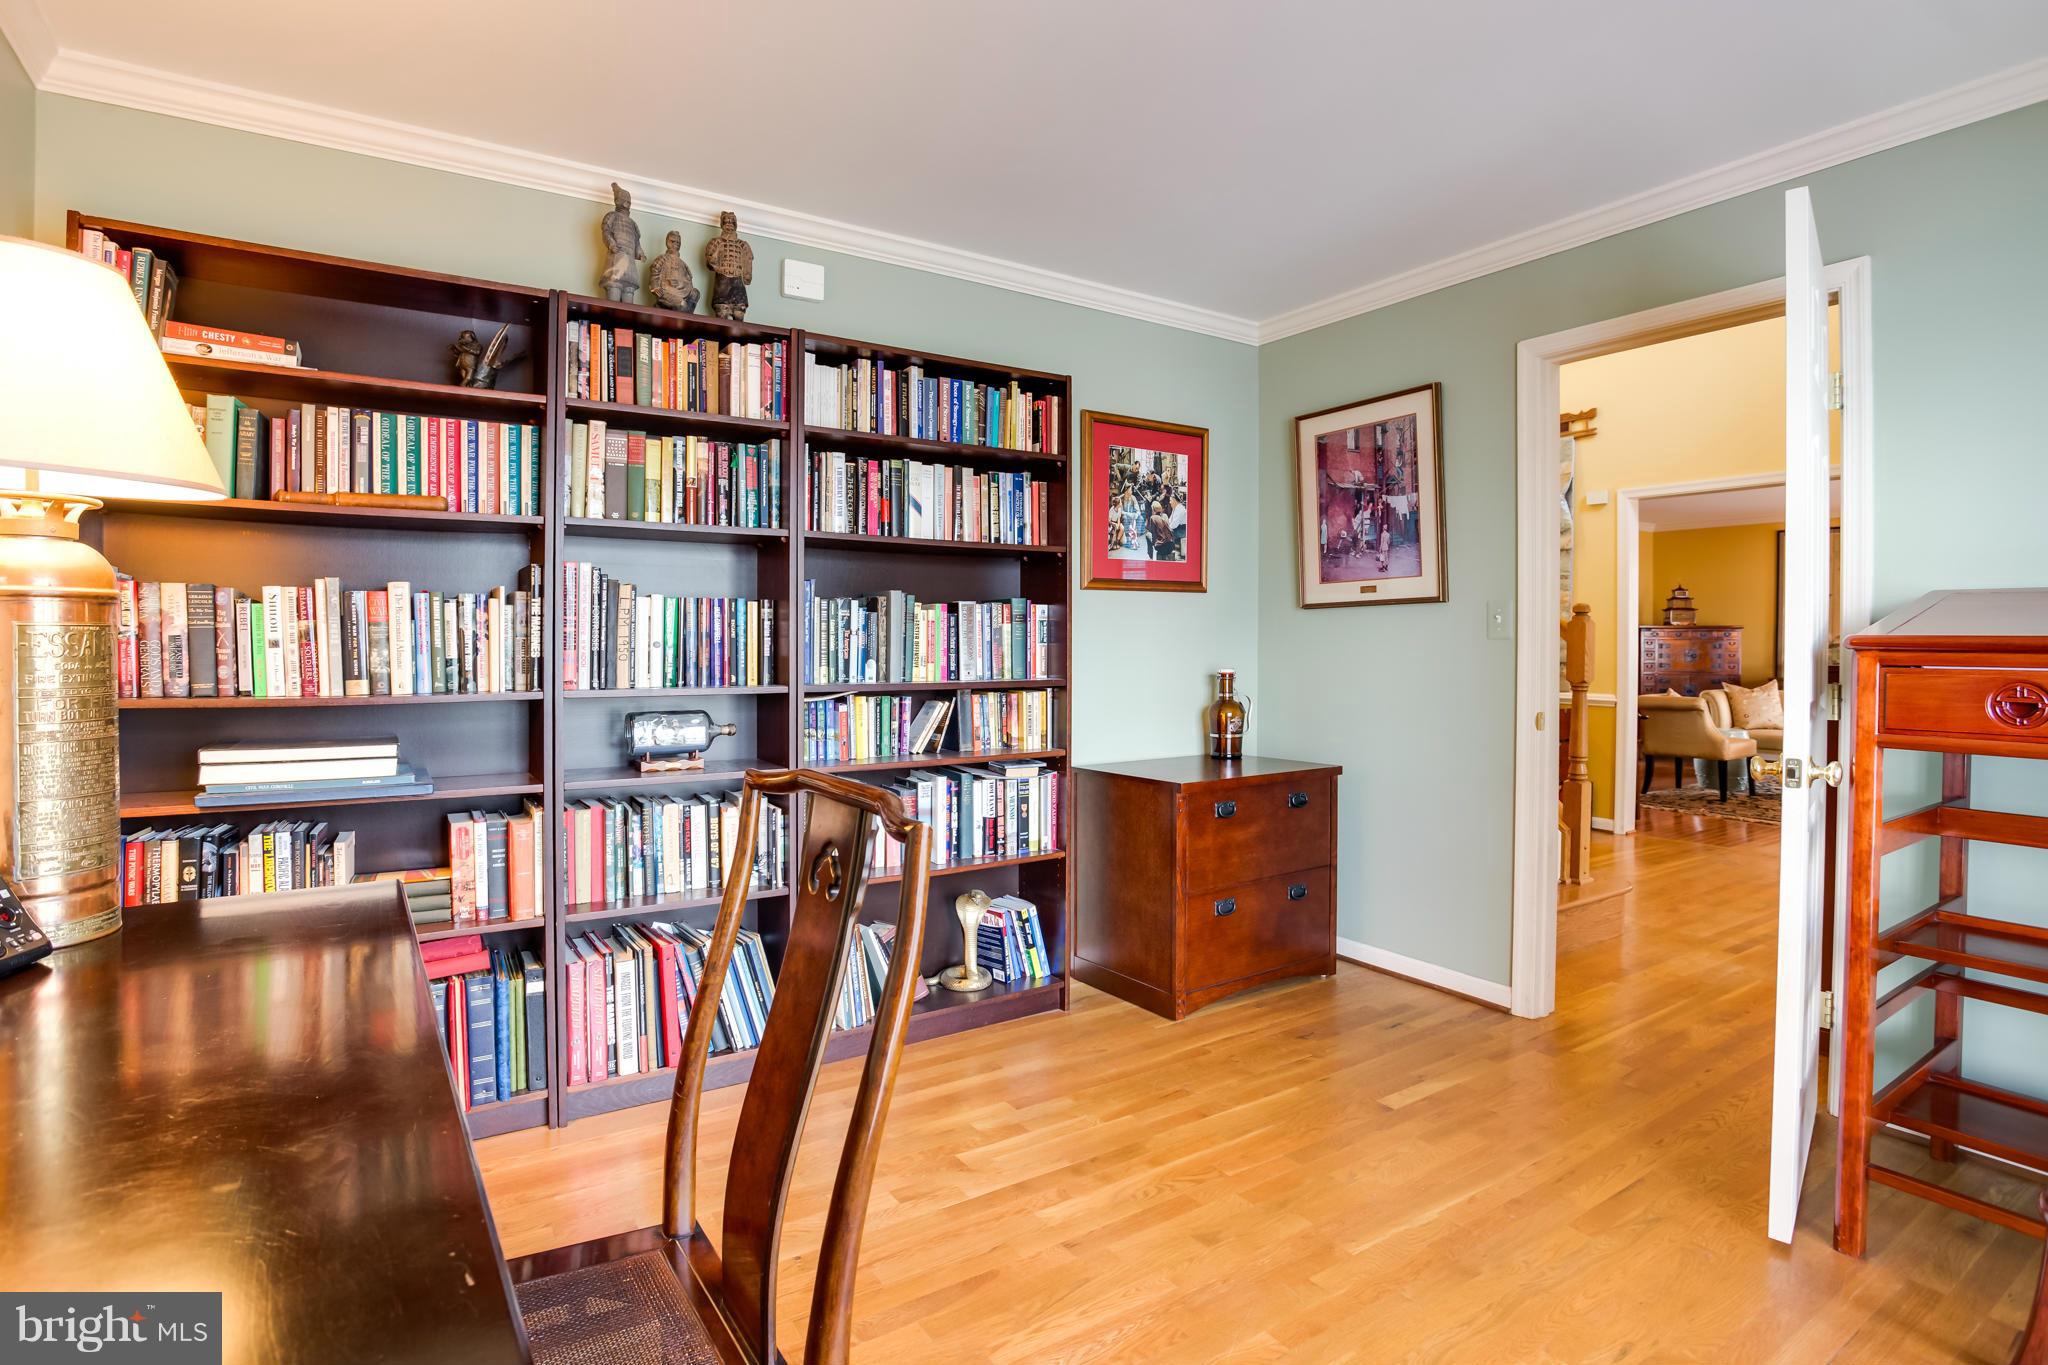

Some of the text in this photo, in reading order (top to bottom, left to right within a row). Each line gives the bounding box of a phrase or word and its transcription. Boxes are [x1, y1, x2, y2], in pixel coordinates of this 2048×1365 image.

[136, 255, 146, 285] REBELS
[202, 330, 236, 343] CHESTY
[381, 417, 391, 449] ORDEAL
[407, 419, 415, 451] ORDEAL
[487, 427, 496, 442] THE
[531, 431, 540, 446] THE
[381, 451, 390, 461] OF
[407, 453, 415, 463] OF
[447, 423, 455, 484] THE EMERGENCE OF
[487, 443, 496, 459] WAR
[531, 447, 540, 463] WAR
[381, 463, 390, 480] THE
[407, 466, 416, 482] THE
[430, 473, 437, 482] OF
[468, 426, 476, 512] THE WAR FOR THE UNION
[487, 460, 496, 474] FOR
[509, 429, 517, 515] THE WAR FOR THE UNION
[531, 464, 540, 478] FOR
[487, 475, 496, 491] THE
[531, 480, 540, 494] THE
[239, 606, 248, 633] REBEL
[268, 593, 278, 633] SHILOH
[531, 597, 541, 658] THE MARINES
[592, 604, 600, 651] FORTRESSES
[619, 635, 629, 662] 1950
[140, 640, 151, 688] GENERALS
[150, 639, 161, 688] GODS AND
[304, 645, 313, 681] SOLDIERS
[36, 698, 79, 710] FOR
[23, 710, 56, 722] TURN
[642, 808, 650, 844] HEROES
[711, 817, 719, 840] BOYS
[264, 835, 274, 851] THE
[711, 842, 719, 853] OF
[128, 848, 136, 897] THE PUNIC WARS
[152, 846, 161, 905] THERMOPYLAE
[278, 857, 289, 879] PACIFIC
[621, 971, 632, 1060] IMAGES FROM THE FLOATING WORLD
